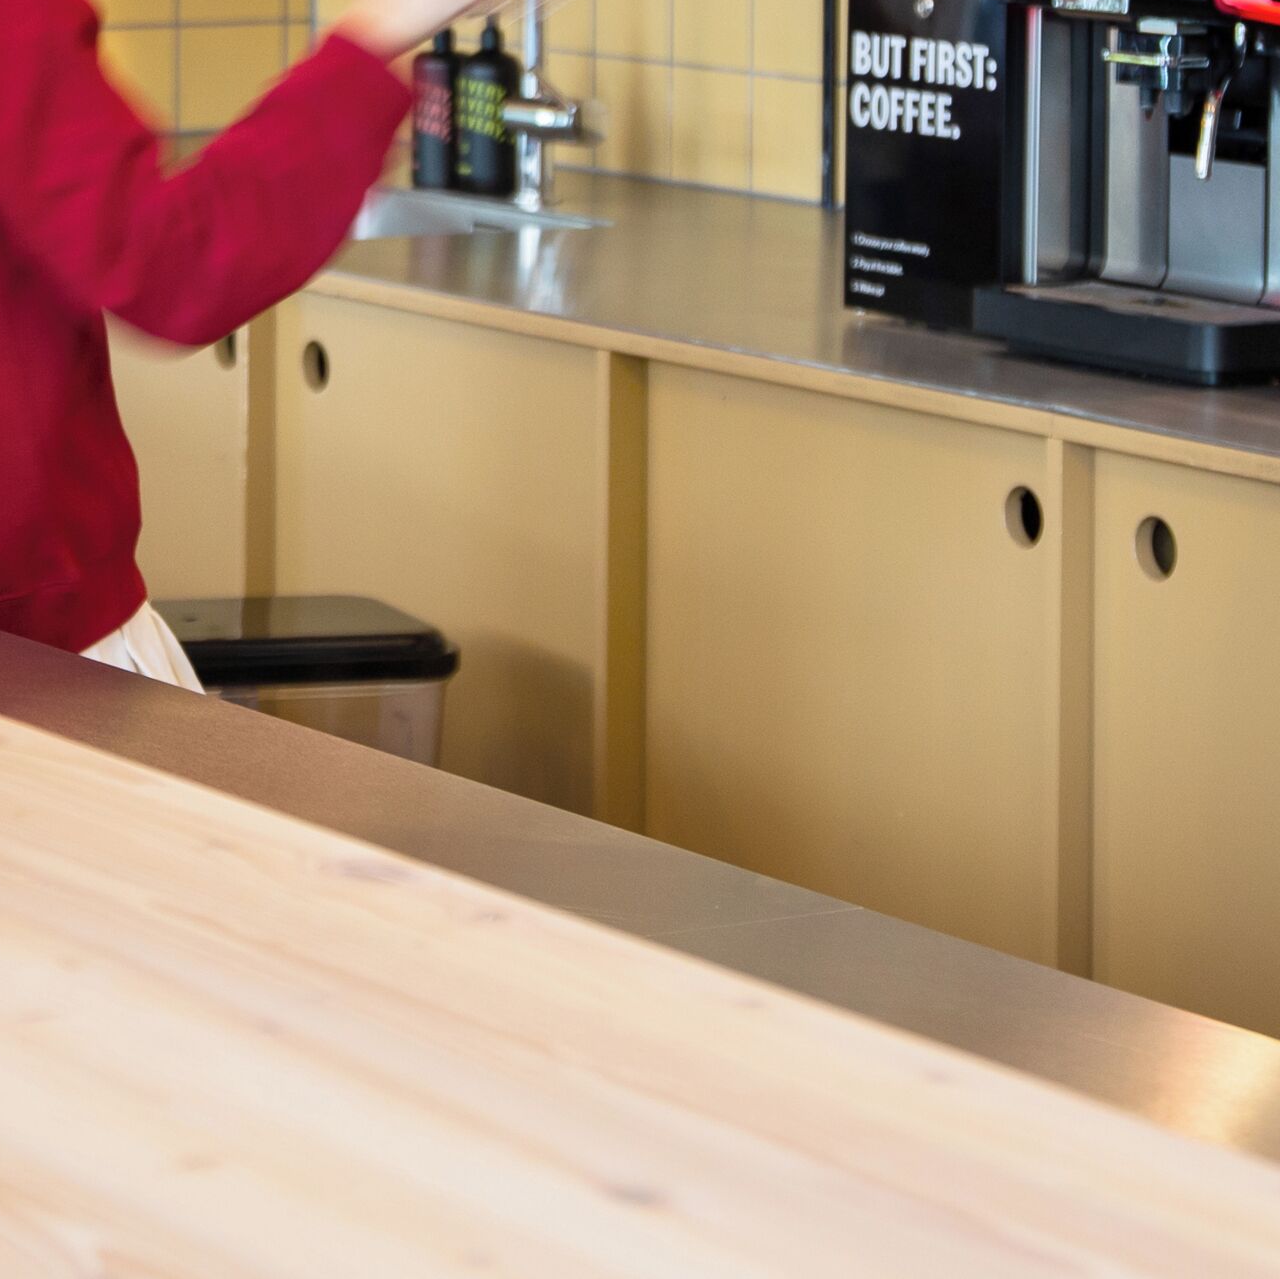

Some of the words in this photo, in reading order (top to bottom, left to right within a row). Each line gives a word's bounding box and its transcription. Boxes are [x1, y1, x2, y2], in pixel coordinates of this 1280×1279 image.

[851, 30, 907, 80] BUT
[910, 36, 997, 92] FIRST:
[850, 81, 961, 140] COFFEE.
